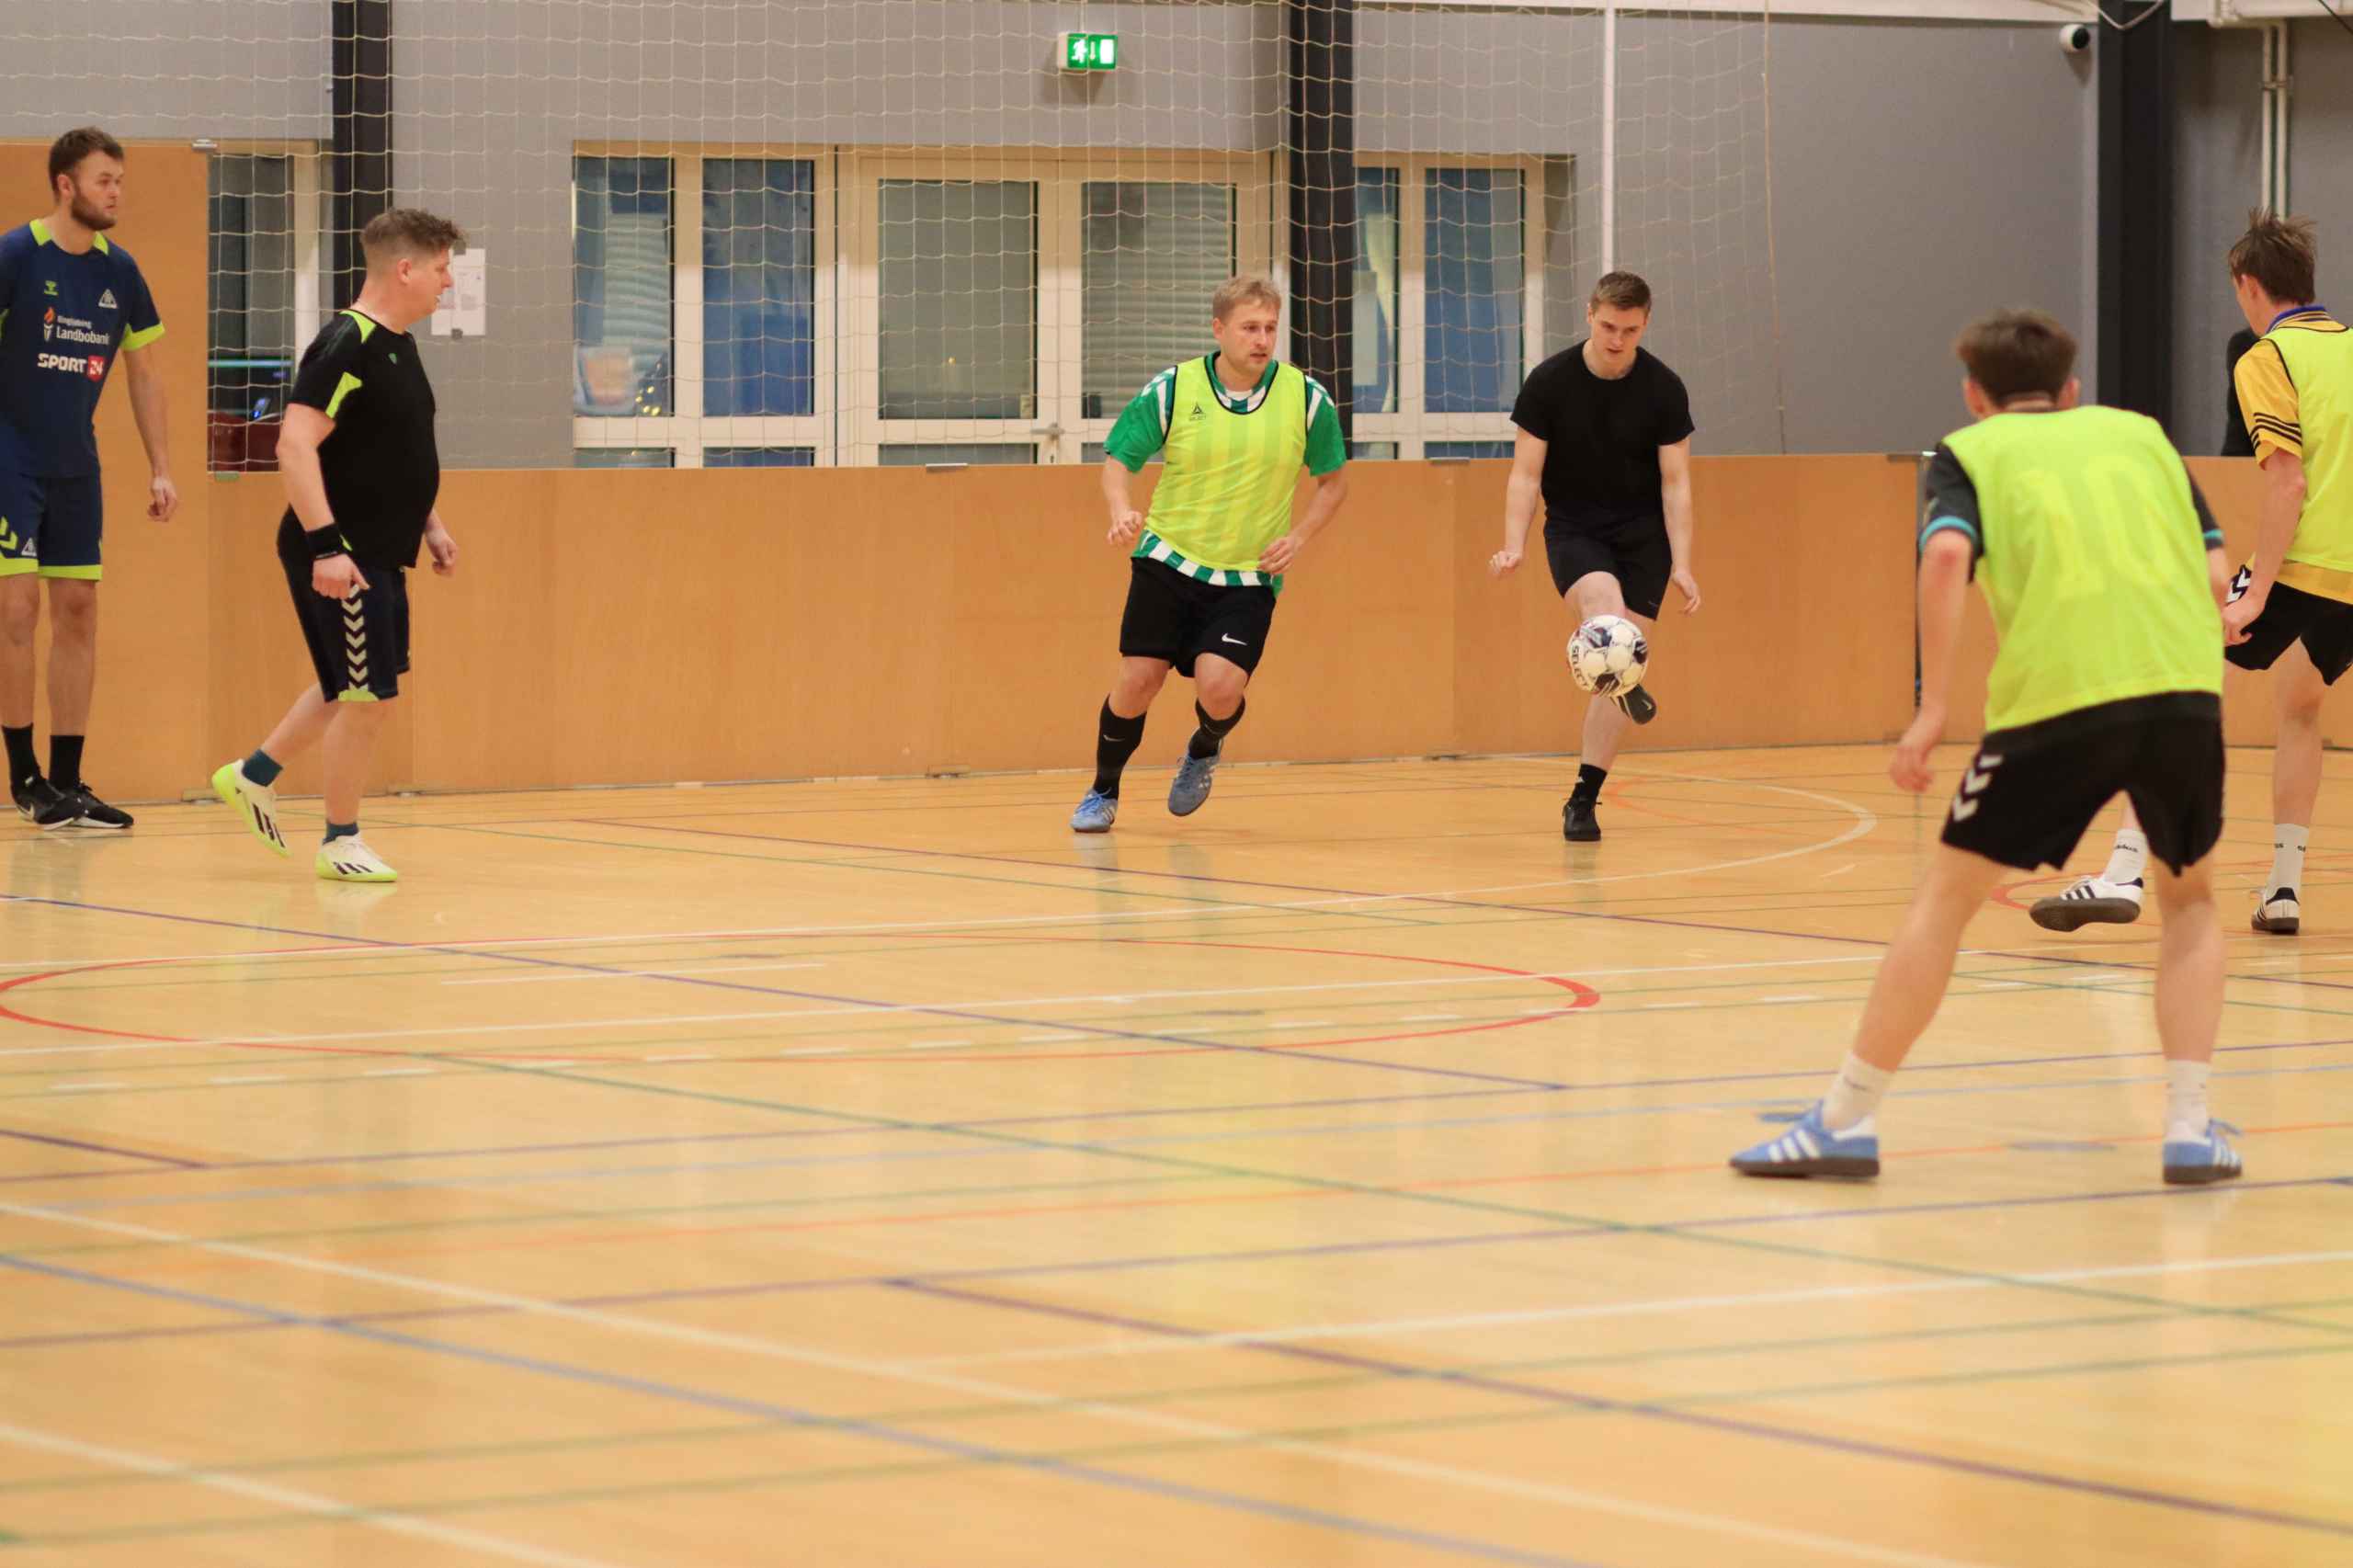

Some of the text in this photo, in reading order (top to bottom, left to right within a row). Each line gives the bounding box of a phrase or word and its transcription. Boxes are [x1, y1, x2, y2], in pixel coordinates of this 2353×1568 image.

[56, 325, 110, 346] Landbobank
[37, 353, 103, 376] SPORT 24
